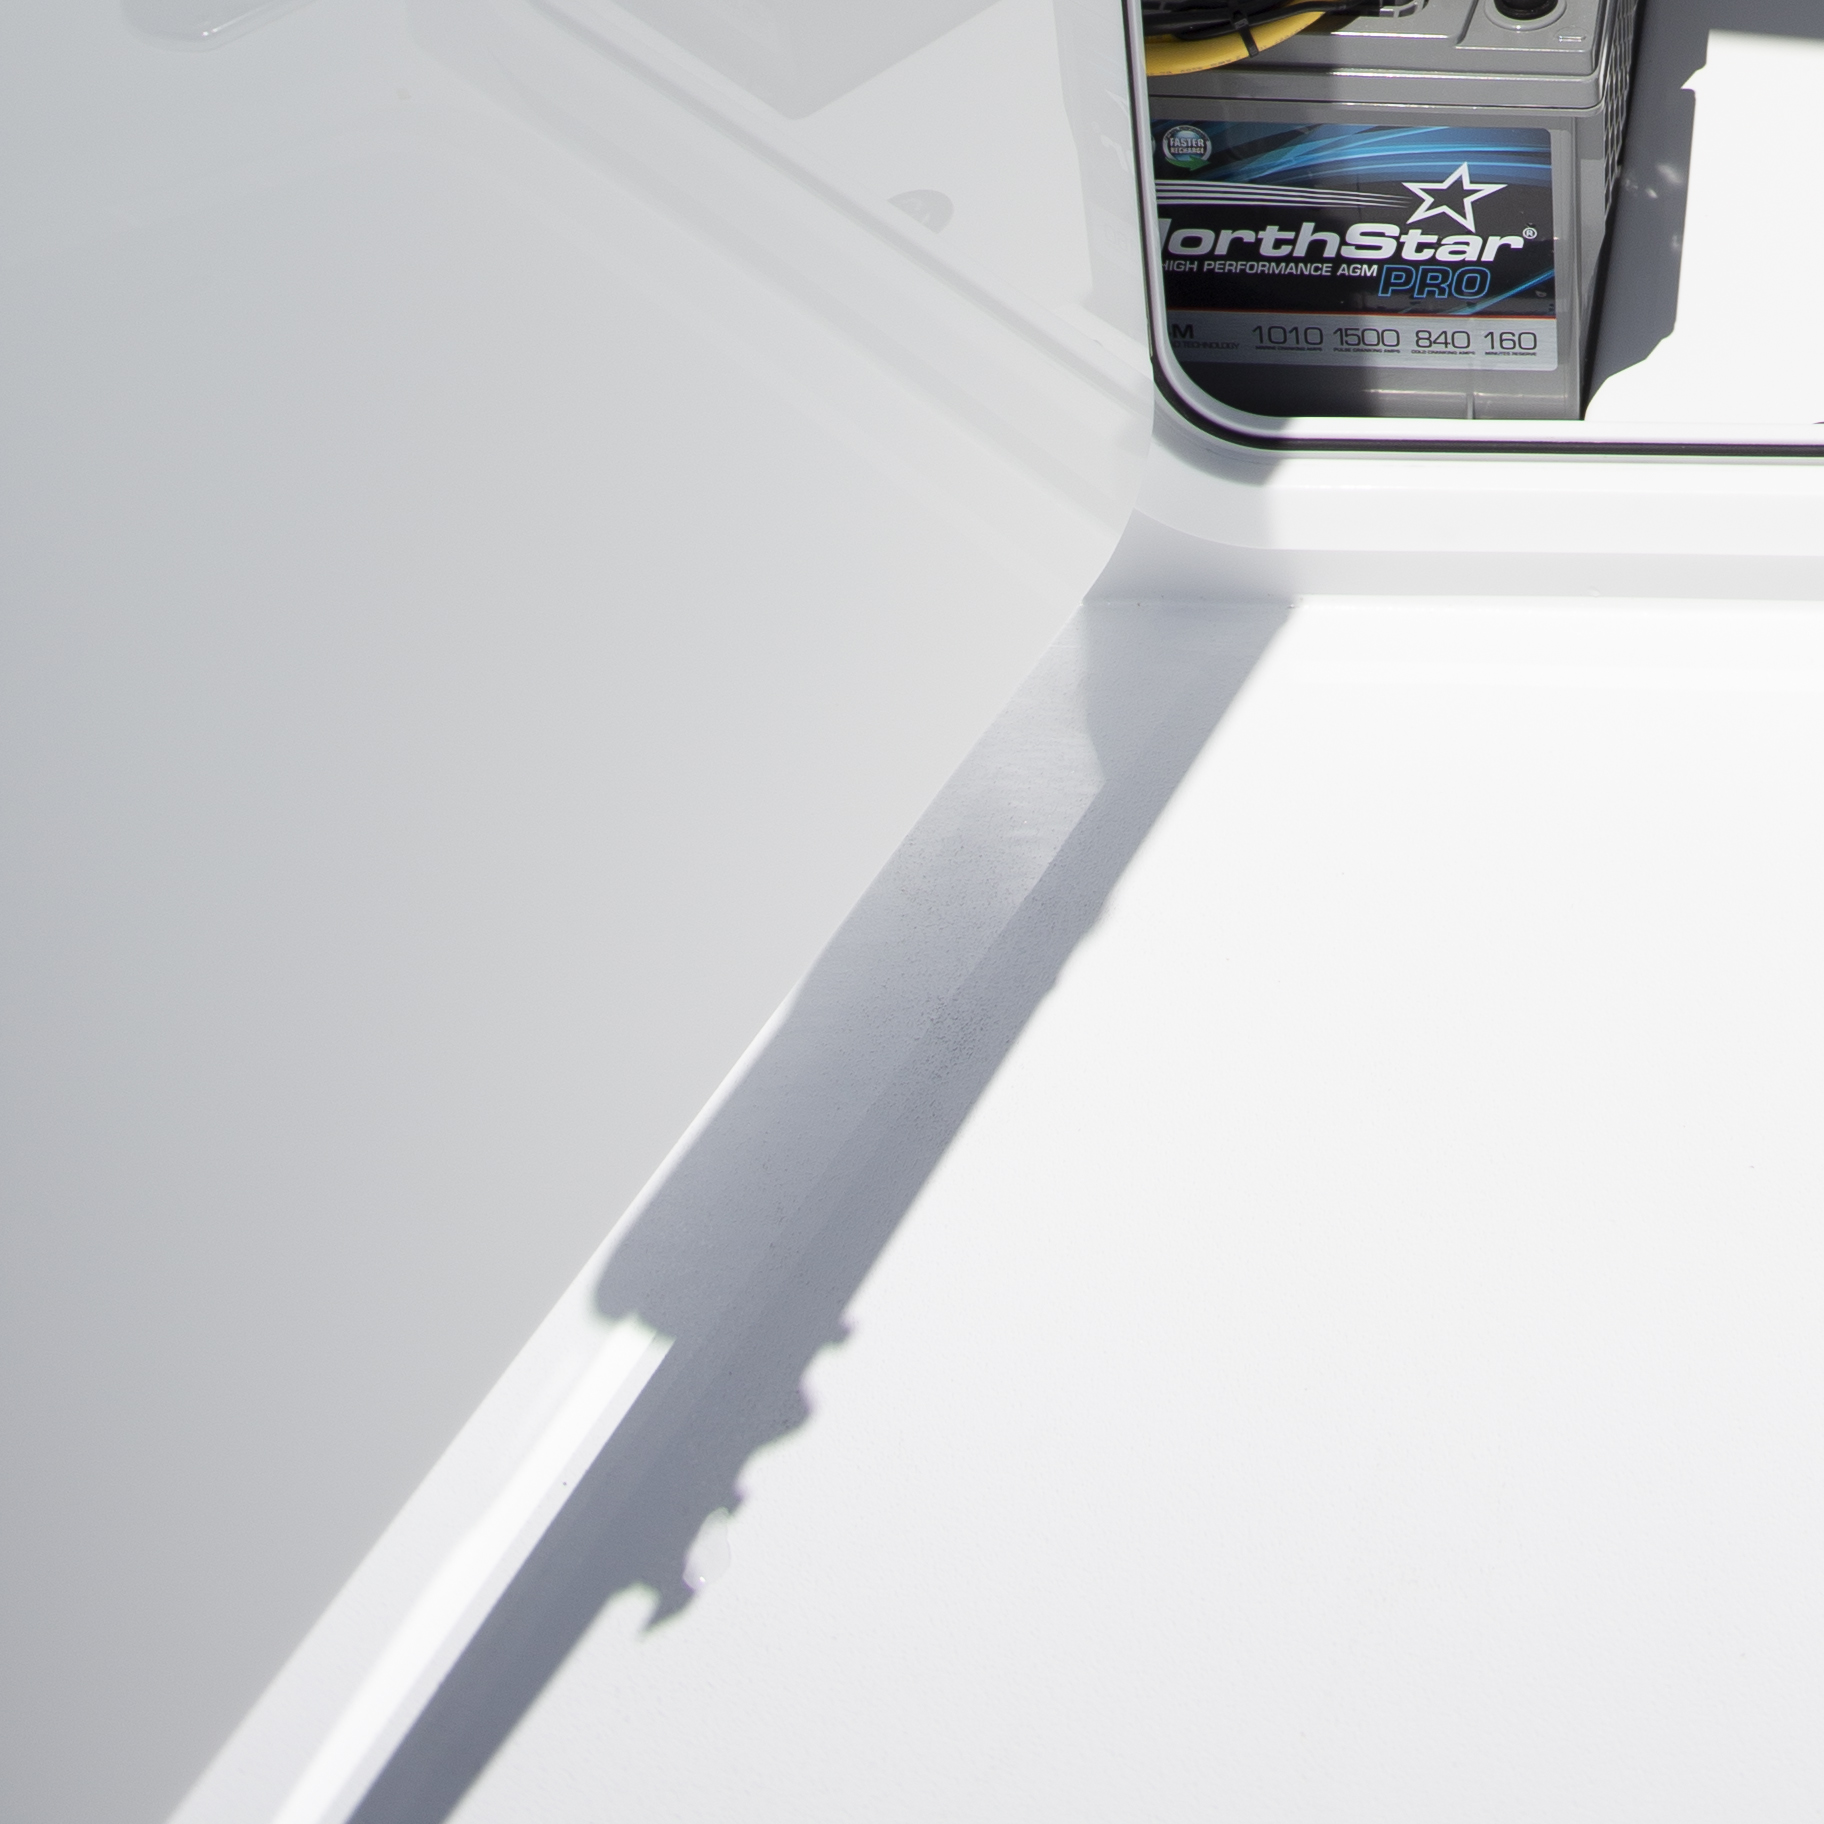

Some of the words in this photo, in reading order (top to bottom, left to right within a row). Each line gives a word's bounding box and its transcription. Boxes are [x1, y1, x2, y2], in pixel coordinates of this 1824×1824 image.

[1169, 138, 1205, 147] FASTER
[1169, 146, 1205, 154] RECHARGE
[1161, 219, 1523, 263] orthStar
[1203, 261, 1333, 276] PERFORMANCE
[1336, 264, 1378, 278] AGM
[1378, 264, 1491, 300] PRO
[1252, 324, 1323, 346] 1010
[1333, 327, 1400, 347] 1500
[1415, 329, 1471, 349] 840
[1483, 330, 1538, 350] 160
[1182, 342, 1240, 351] TECHNOLOGY
